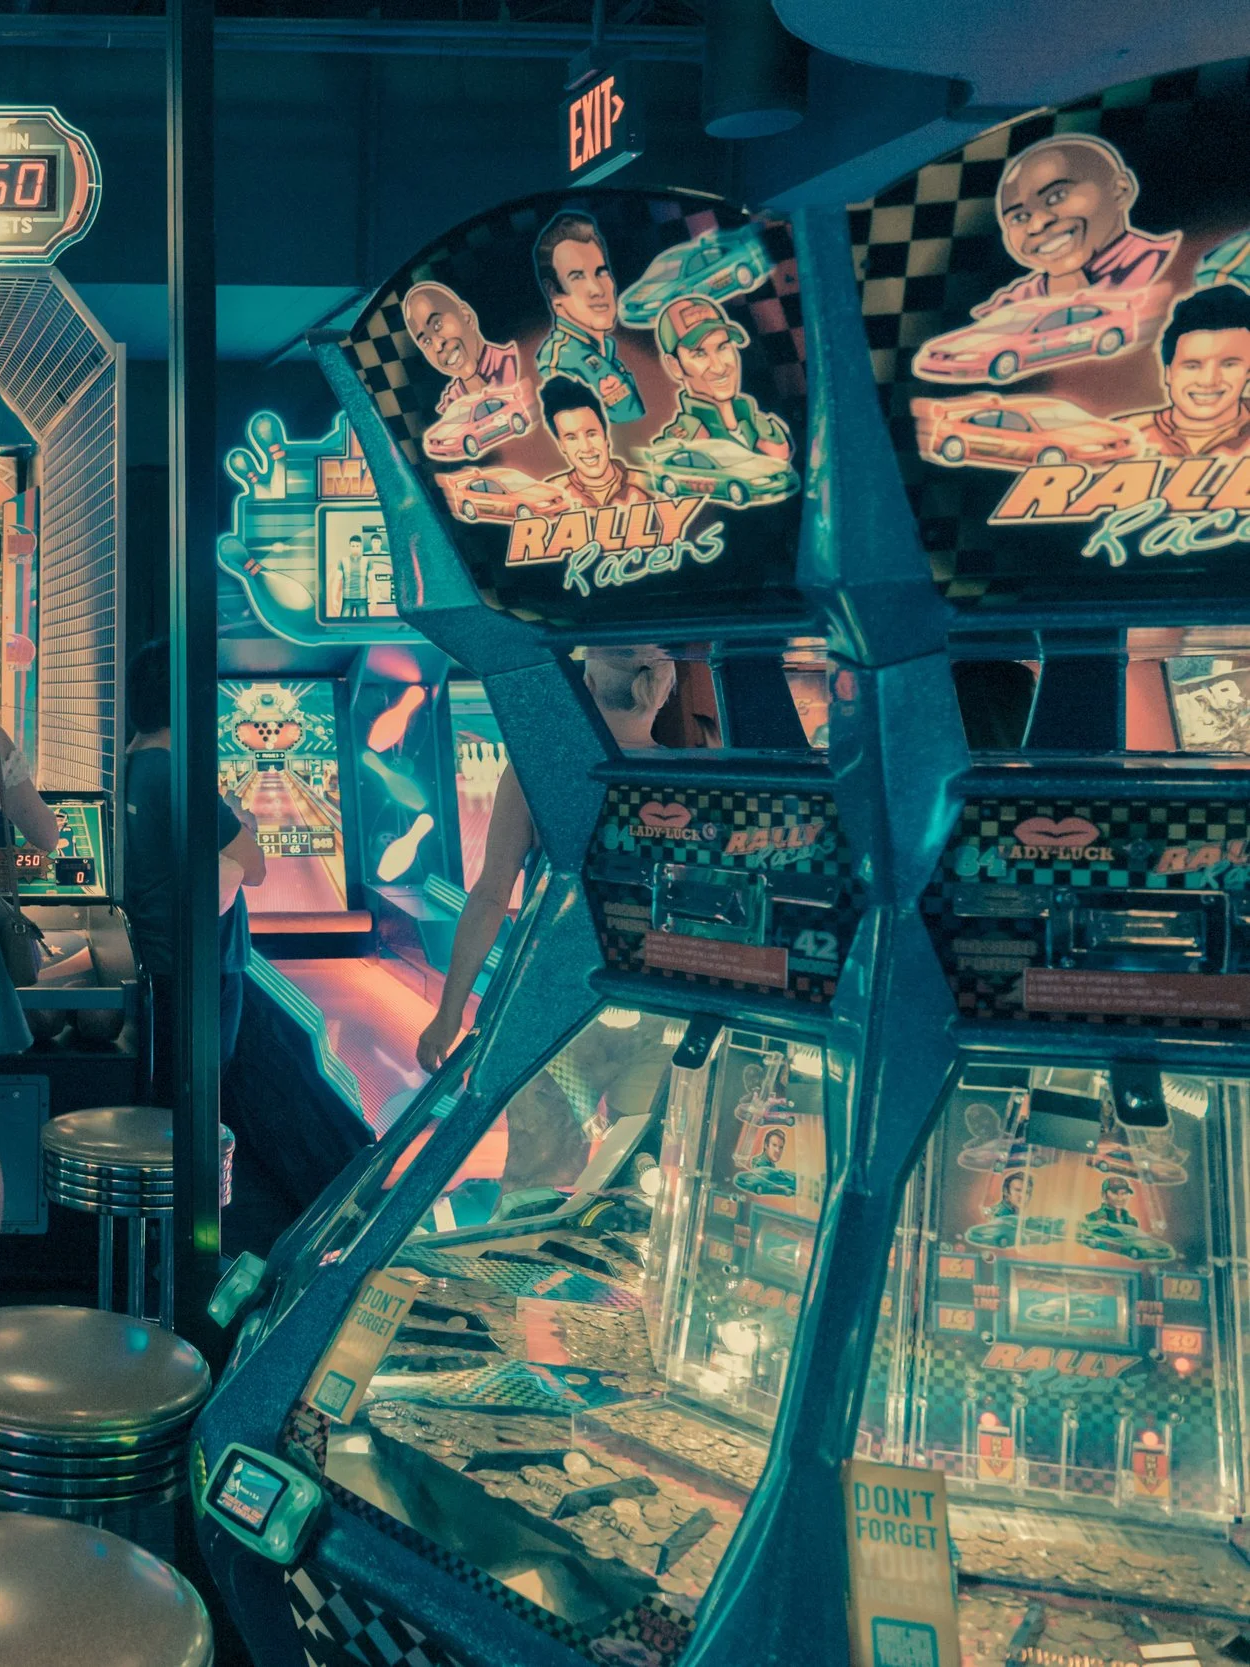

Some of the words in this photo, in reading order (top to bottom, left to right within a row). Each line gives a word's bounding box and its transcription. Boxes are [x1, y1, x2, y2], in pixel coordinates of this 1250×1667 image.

[569, 75, 615, 171] EXIT
[987, 457, 1250, 526] RALL
[507, 496, 707, 566] RALLY
[562, 520, 726, 597] Racers
[723, 823, 825, 856] RALLY
[15, 855, 40, 867] 250
[792, 929, 839, 960] 42
[360, 1285, 407, 1318] DON'T
[351, 1307, 395, 1337] FORGET
[1165, 1333, 1197, 1349] 20
[981, 1343, 1144, 1379] RALLY
[528, 1477, 563, 1497] OVER
[854, 1482, 935, 1521] DON'T
[855, 1516, 938, 1552] FORGET
